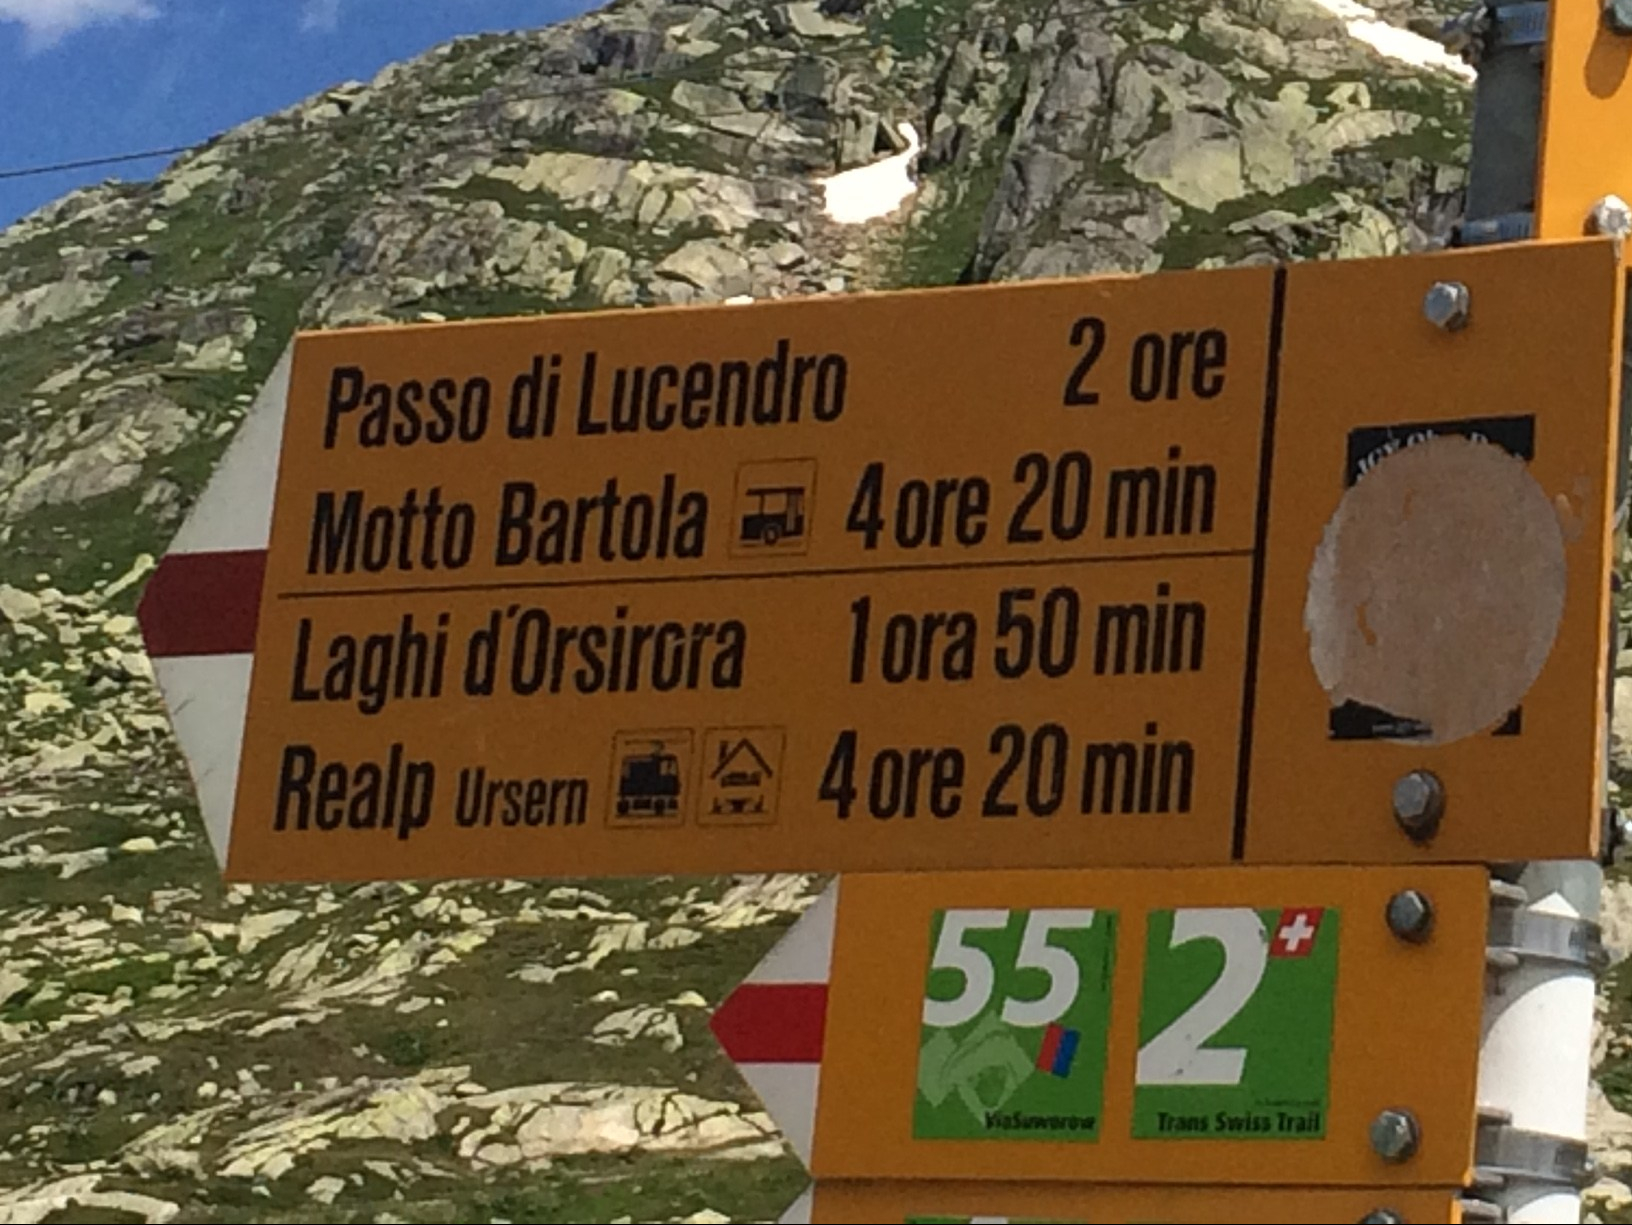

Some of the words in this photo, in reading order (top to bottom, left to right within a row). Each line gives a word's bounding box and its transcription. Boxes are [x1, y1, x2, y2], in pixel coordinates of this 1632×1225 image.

[323, 366, 491, 450] Passo
[507, 353, 562, 440] di
[576, 338, 848, 436] Lucendro
[306, 486, 476, 575] Motto
[494, 473, 708, 567] Bartola
[1006, 450, 1092, 544] 20
[1104, 445, 1217, 539] min
[290, 612, 451, 716] Laghi
[994, 586, 1080, 679] 50
[1093, 582, 1206, 676] min
[273, 742, 435, 841] Realp
[455, 766, 589, 828] Ursern
[981, 723, 1069, 818] 20
[1080, 721, 1195, 815] min
[923, 909, 1096, 1026] 55
[1136, 907, 1271, 1085] 2
[1157, 1112, 1209, 1133] Trans
[1214, 1111, 1271, 1133] Swiss
[1277, 1111, 1321, 1133] Trail
